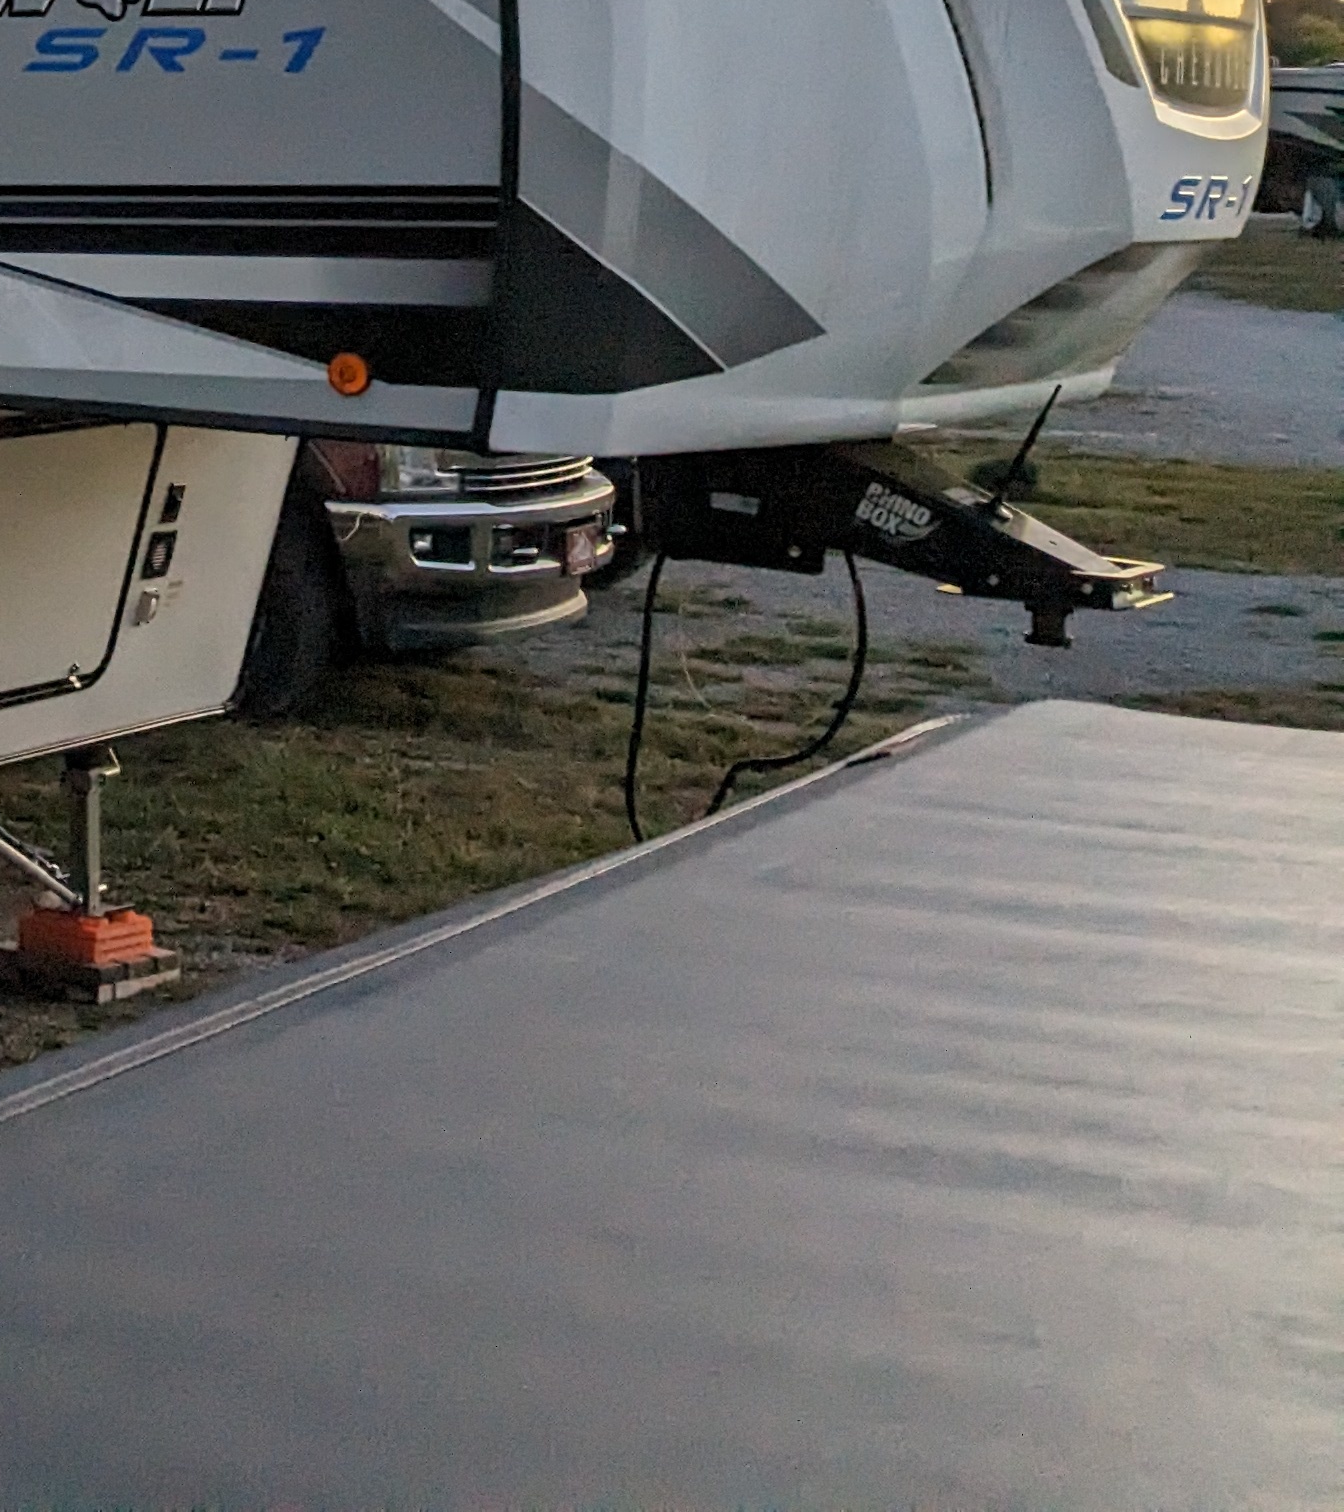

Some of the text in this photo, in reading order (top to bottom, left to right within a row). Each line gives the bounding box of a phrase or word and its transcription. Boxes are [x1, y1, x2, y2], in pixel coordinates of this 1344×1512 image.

[21, 26, 326, 73] SR-1
[1159, 174, 1253, 221] SR-1
[856, 498, 903, 536] BOX
